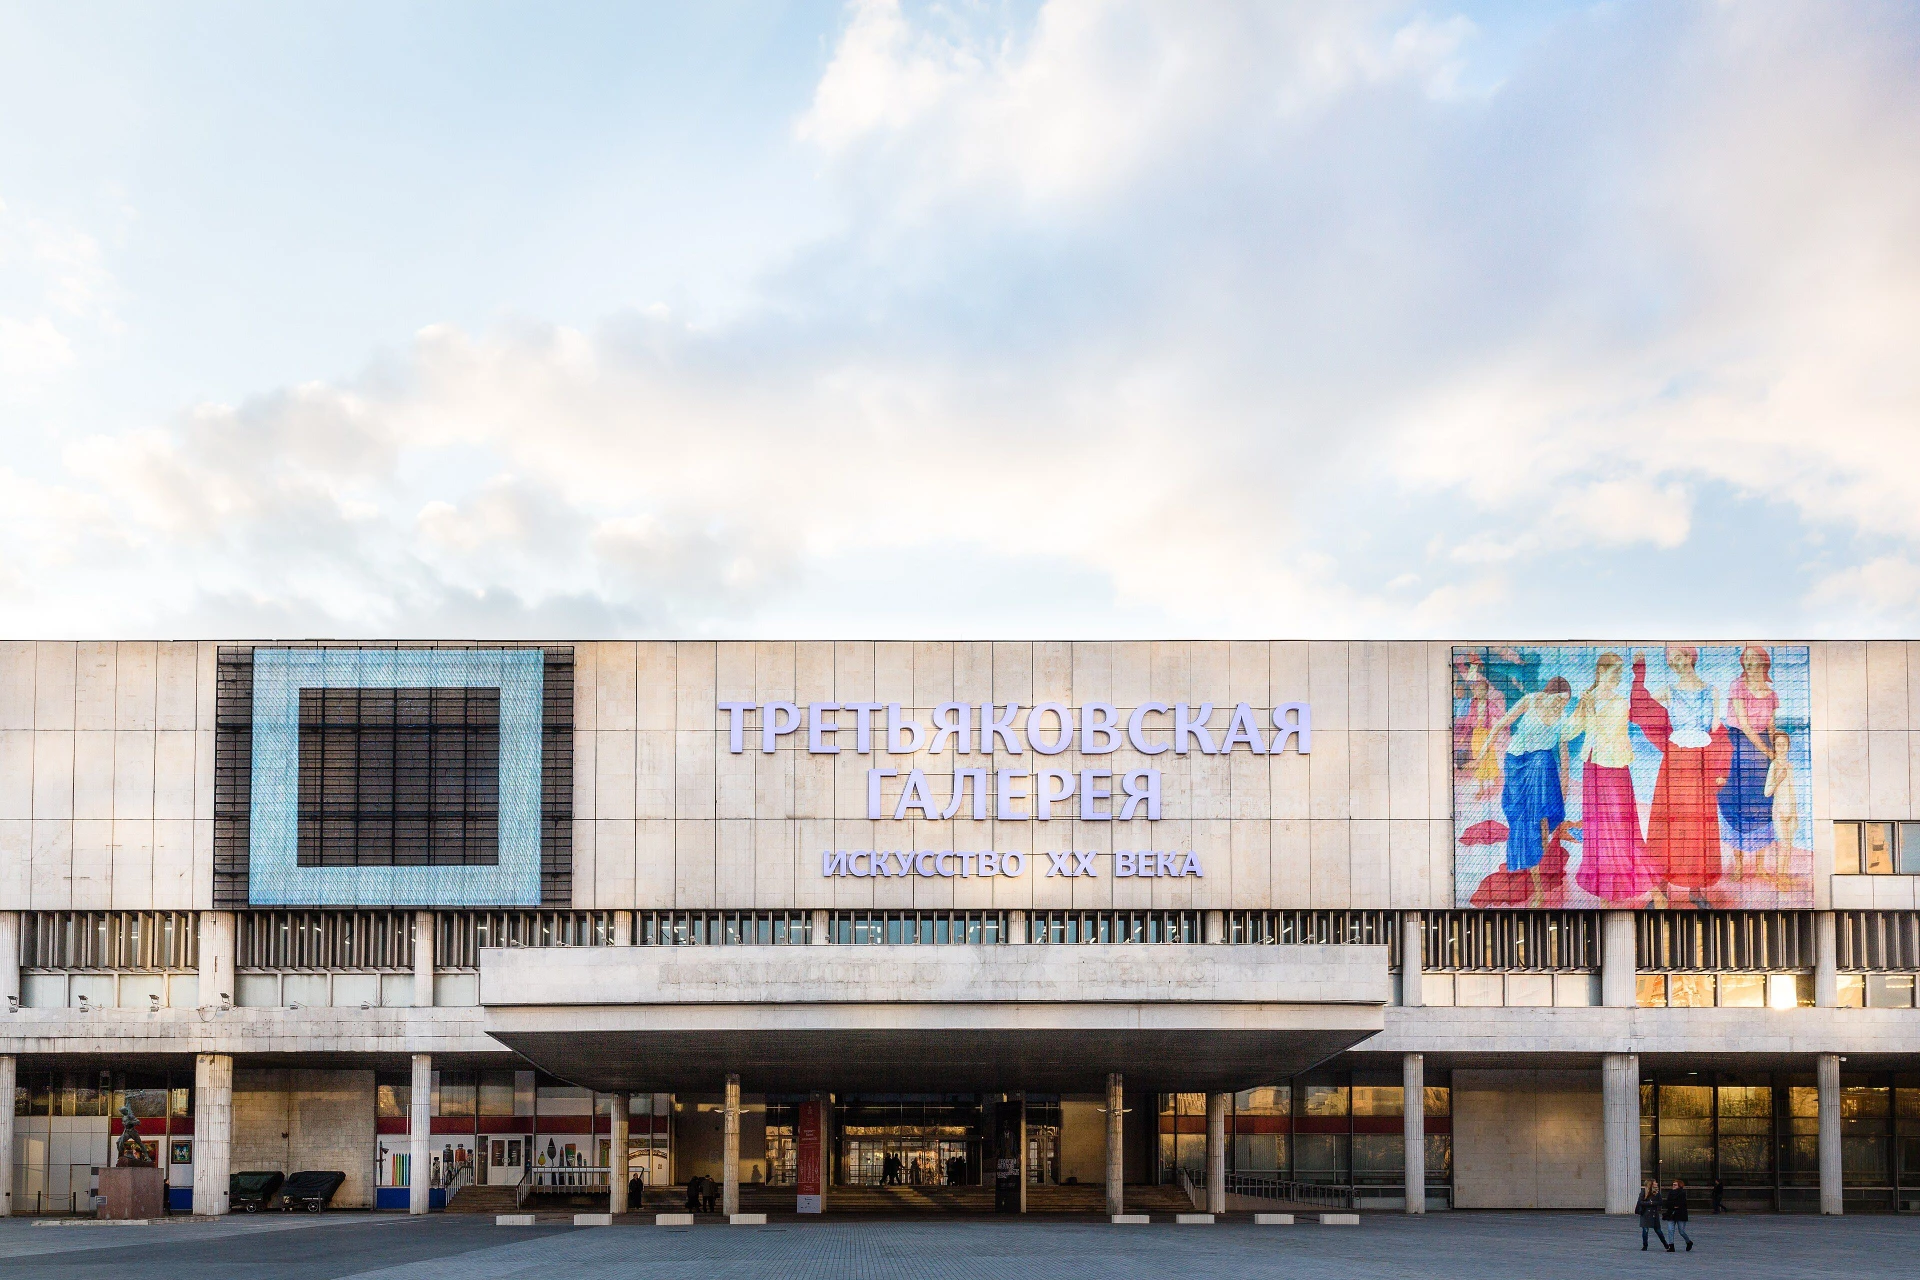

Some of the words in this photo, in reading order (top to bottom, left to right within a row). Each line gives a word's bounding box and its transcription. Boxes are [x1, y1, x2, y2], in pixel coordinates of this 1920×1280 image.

[718, 701, 1312, 755] ТРЕТЬЯКОВСКАЯ
[868, 768, 1163, 821] ГАЛЕРЕЯ
[822, 850, 1026, 878] ИСКУССТВО
[1115, 850, 1205, 878] ВЕКА
